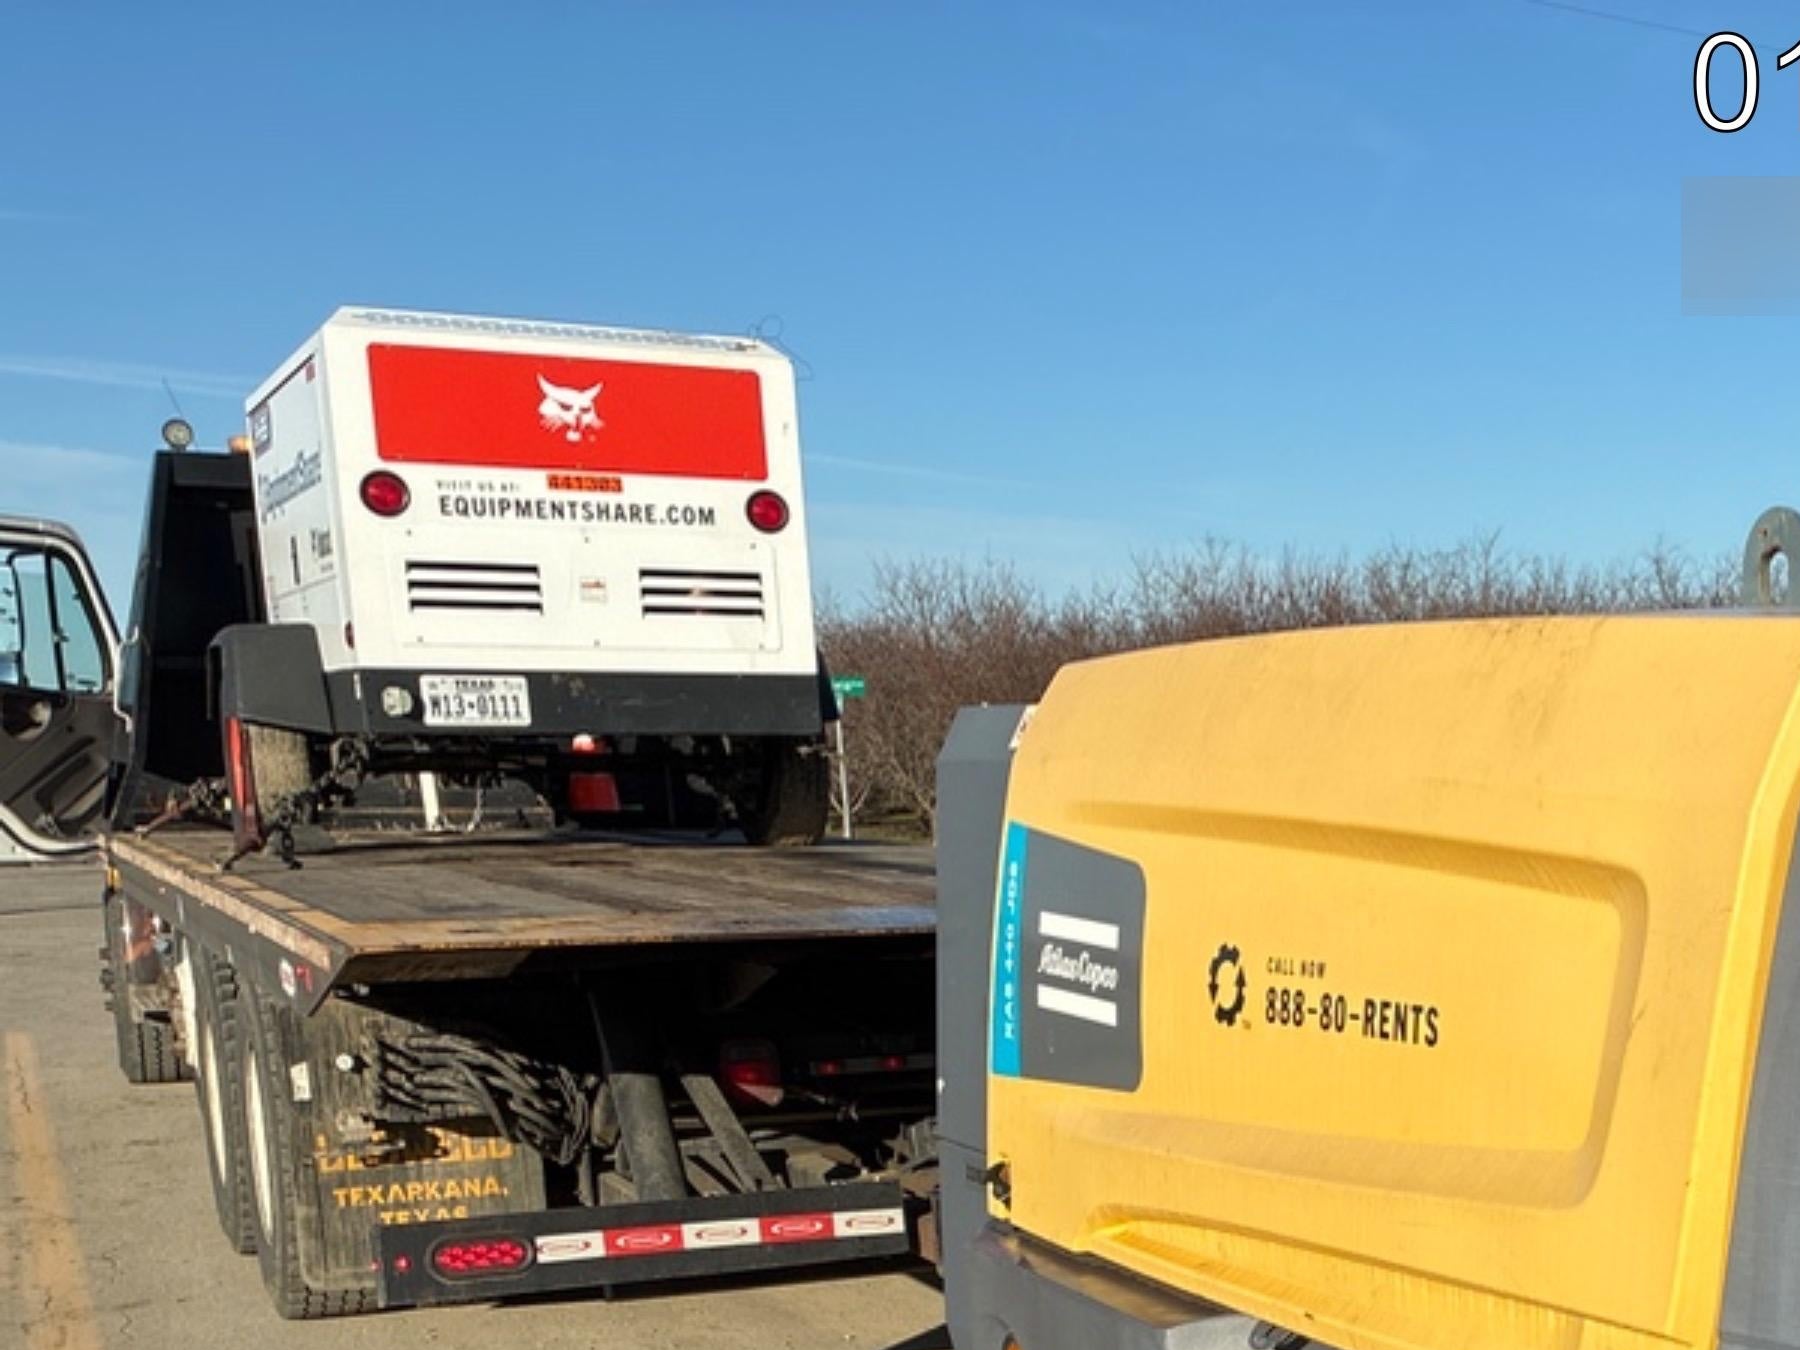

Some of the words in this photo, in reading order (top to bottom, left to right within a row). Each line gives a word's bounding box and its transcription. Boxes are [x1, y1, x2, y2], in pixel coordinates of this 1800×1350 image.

[439, 496, 716, 526] EQUIPMENTSHARE.COM
[1266, 956, 1295, 976] CALL
[1301, 959, 1326, 979] NOW
[1266, 986, 1439, 1048] 888-80-RENTS
[333, 1175, 509, 1209] TEXARKANA,
